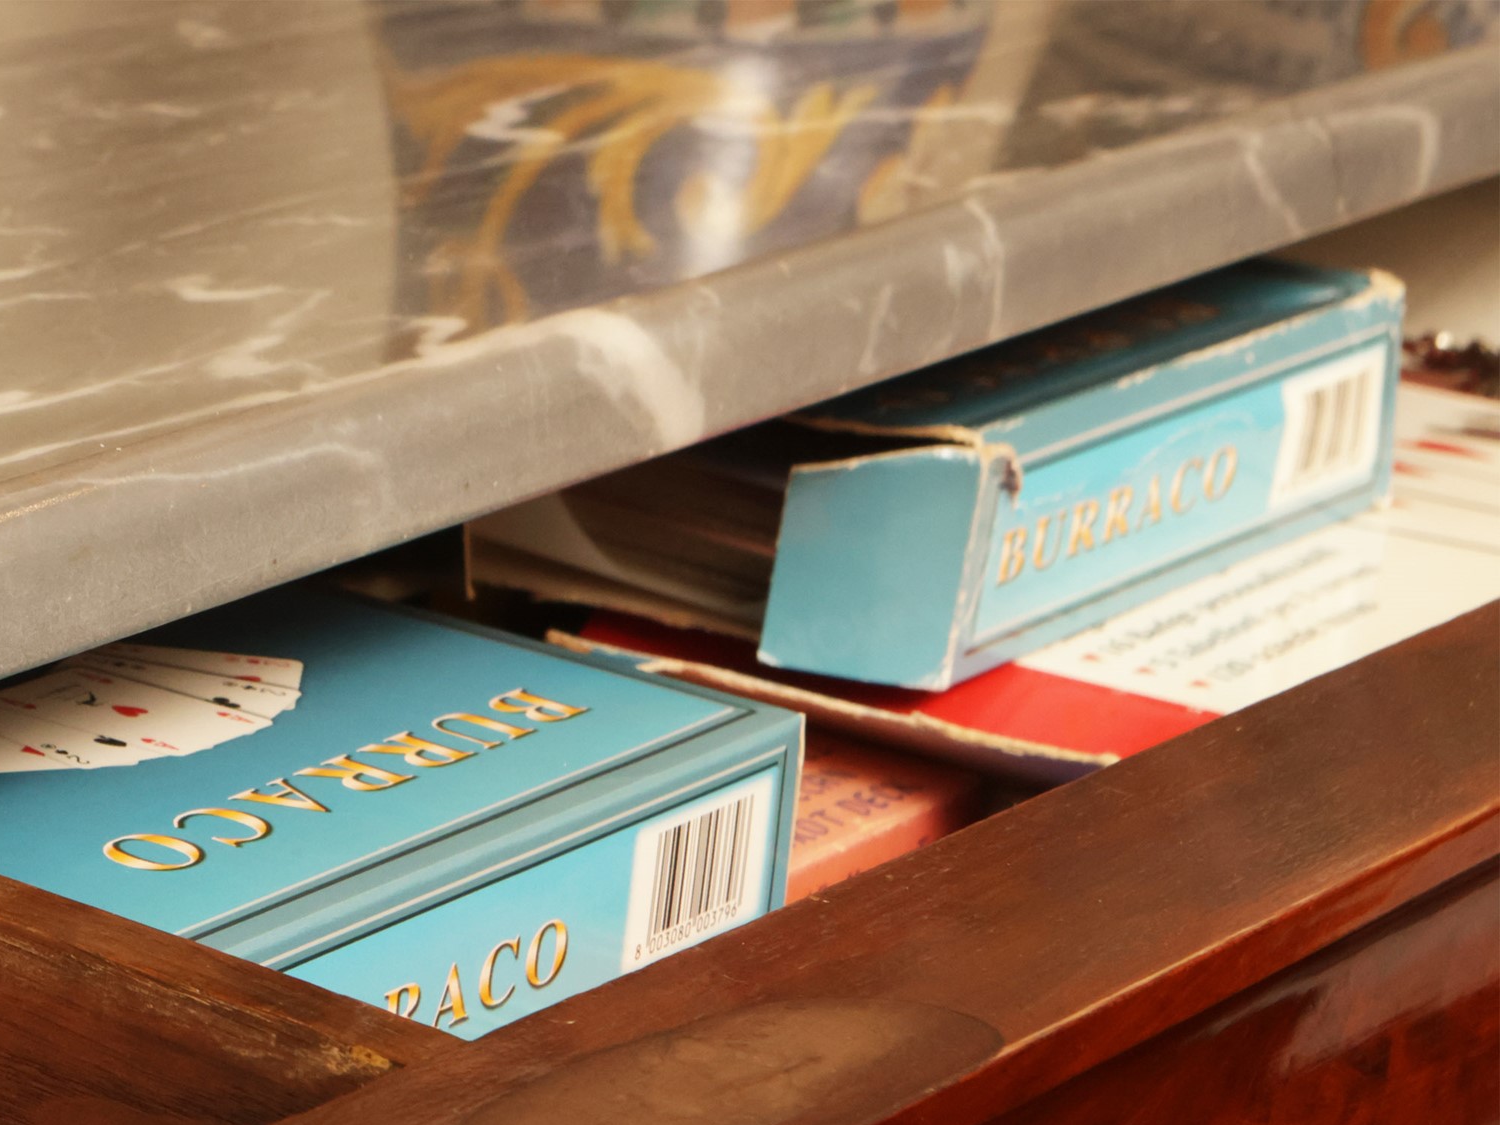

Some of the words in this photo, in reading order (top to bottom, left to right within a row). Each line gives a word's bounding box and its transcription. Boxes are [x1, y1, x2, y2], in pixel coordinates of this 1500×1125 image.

[996, 444, 1238, 587] BURRACO
[103, 688, 592, 871] BURRACO
[634, 944, 642, 960] 8
[648, 922, 692, 954] 003080
[696, 904, 737, 933] 003796
